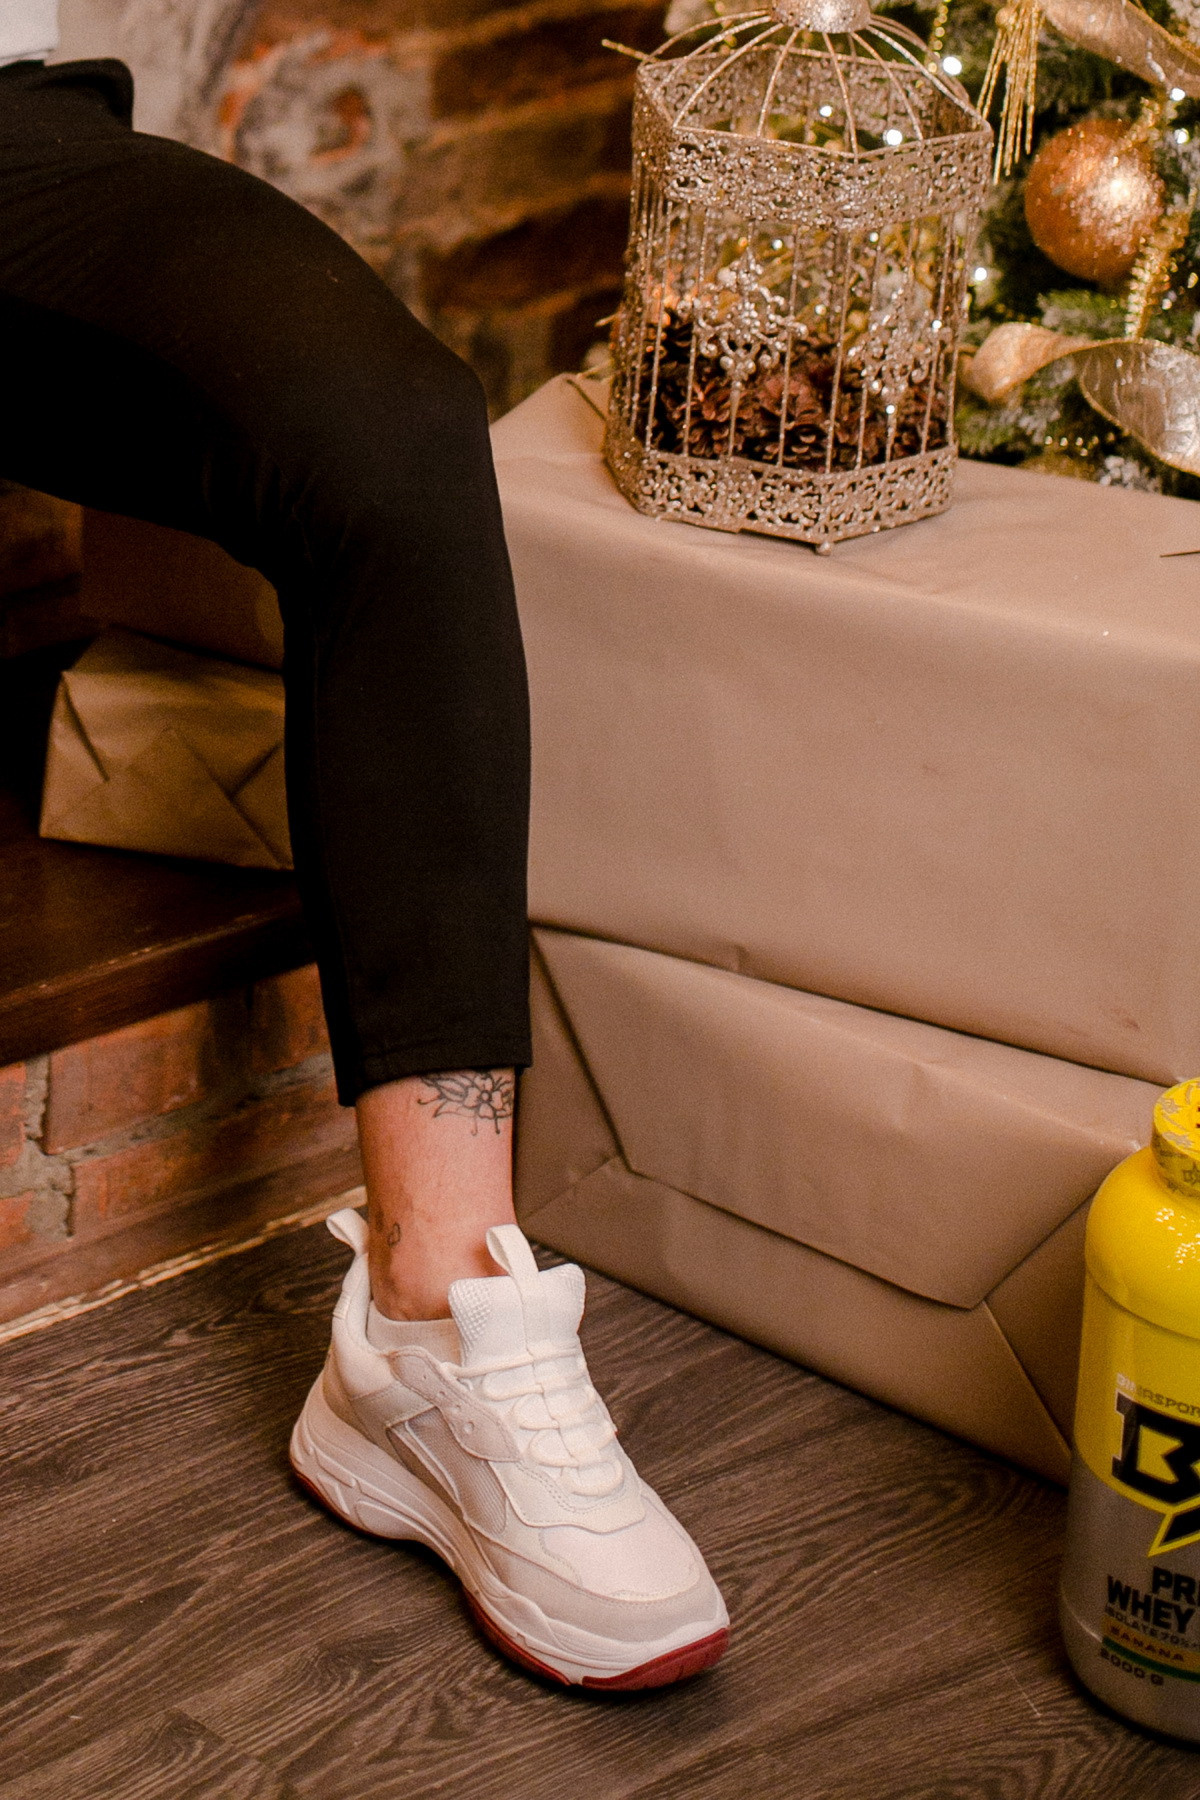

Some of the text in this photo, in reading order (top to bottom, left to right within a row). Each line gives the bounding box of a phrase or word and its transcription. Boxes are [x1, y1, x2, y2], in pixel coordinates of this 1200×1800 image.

[1107, 1573, 1196, 1634] WHEY
[1152, 1565, 1200, 1607] PR
[1110, 1625, 1185, 1662] BANANA
